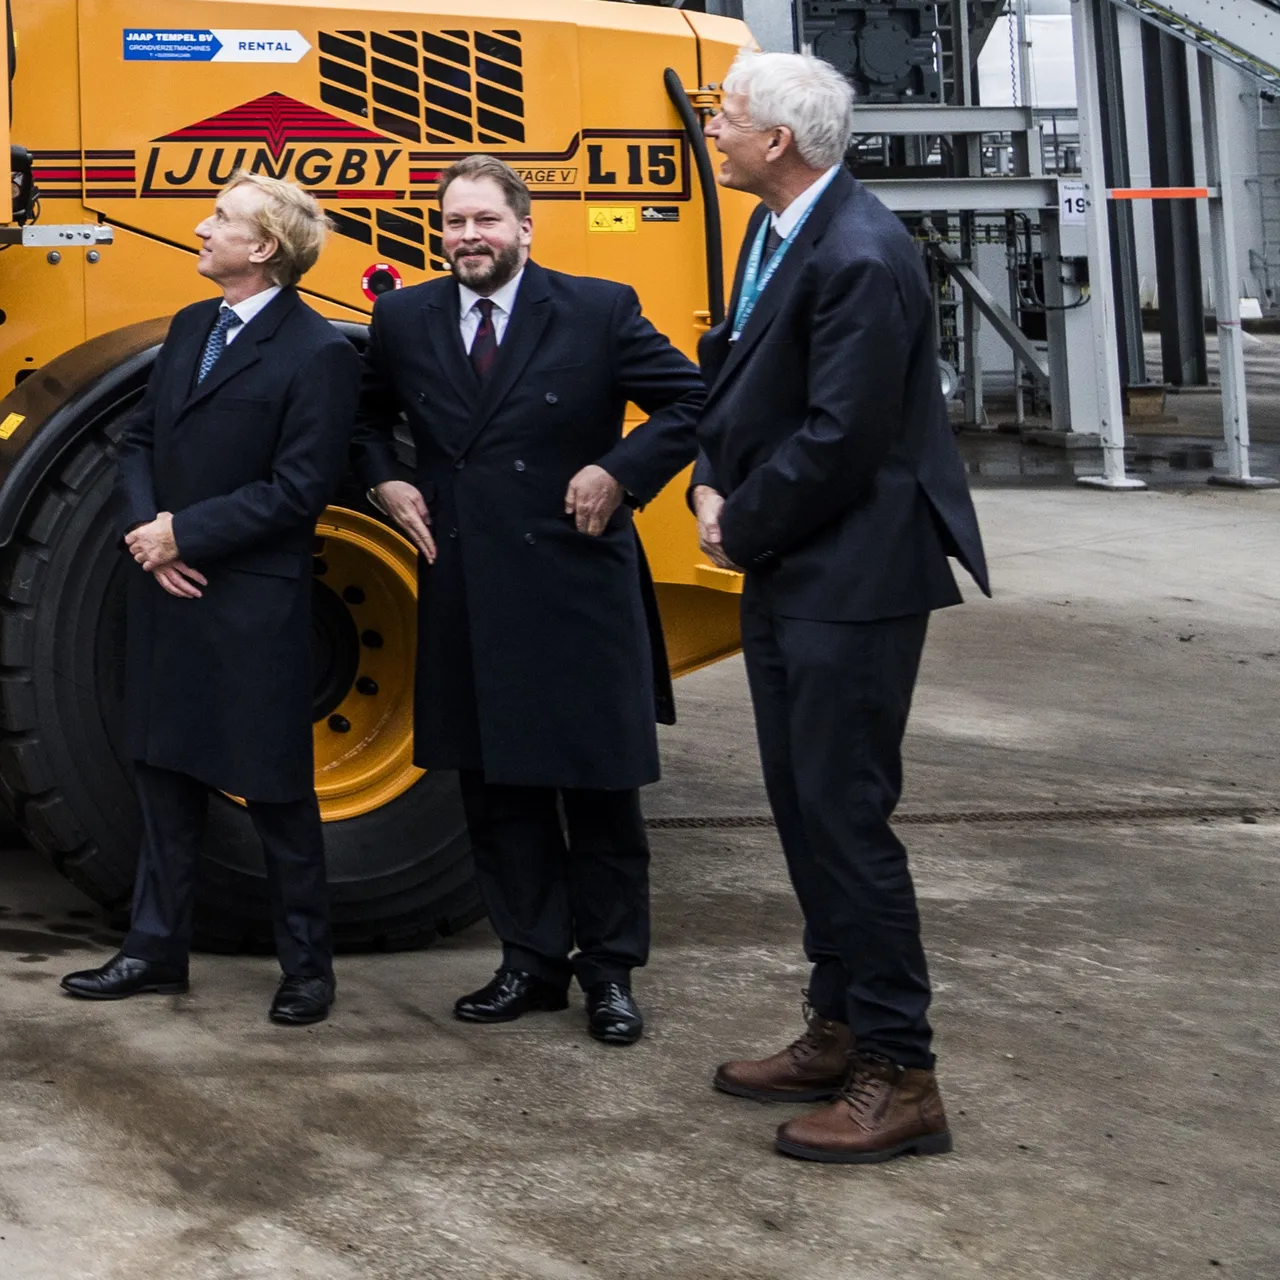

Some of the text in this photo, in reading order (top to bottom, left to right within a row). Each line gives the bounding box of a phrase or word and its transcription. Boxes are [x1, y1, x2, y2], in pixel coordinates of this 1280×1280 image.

[126, 33, 214, 42] JAAP TEMPEL BV
[238, 41, 292, 51] RENTAL
[518, 170, 556, 182] TAGE
[1064, 197, 1085, 214] 19
